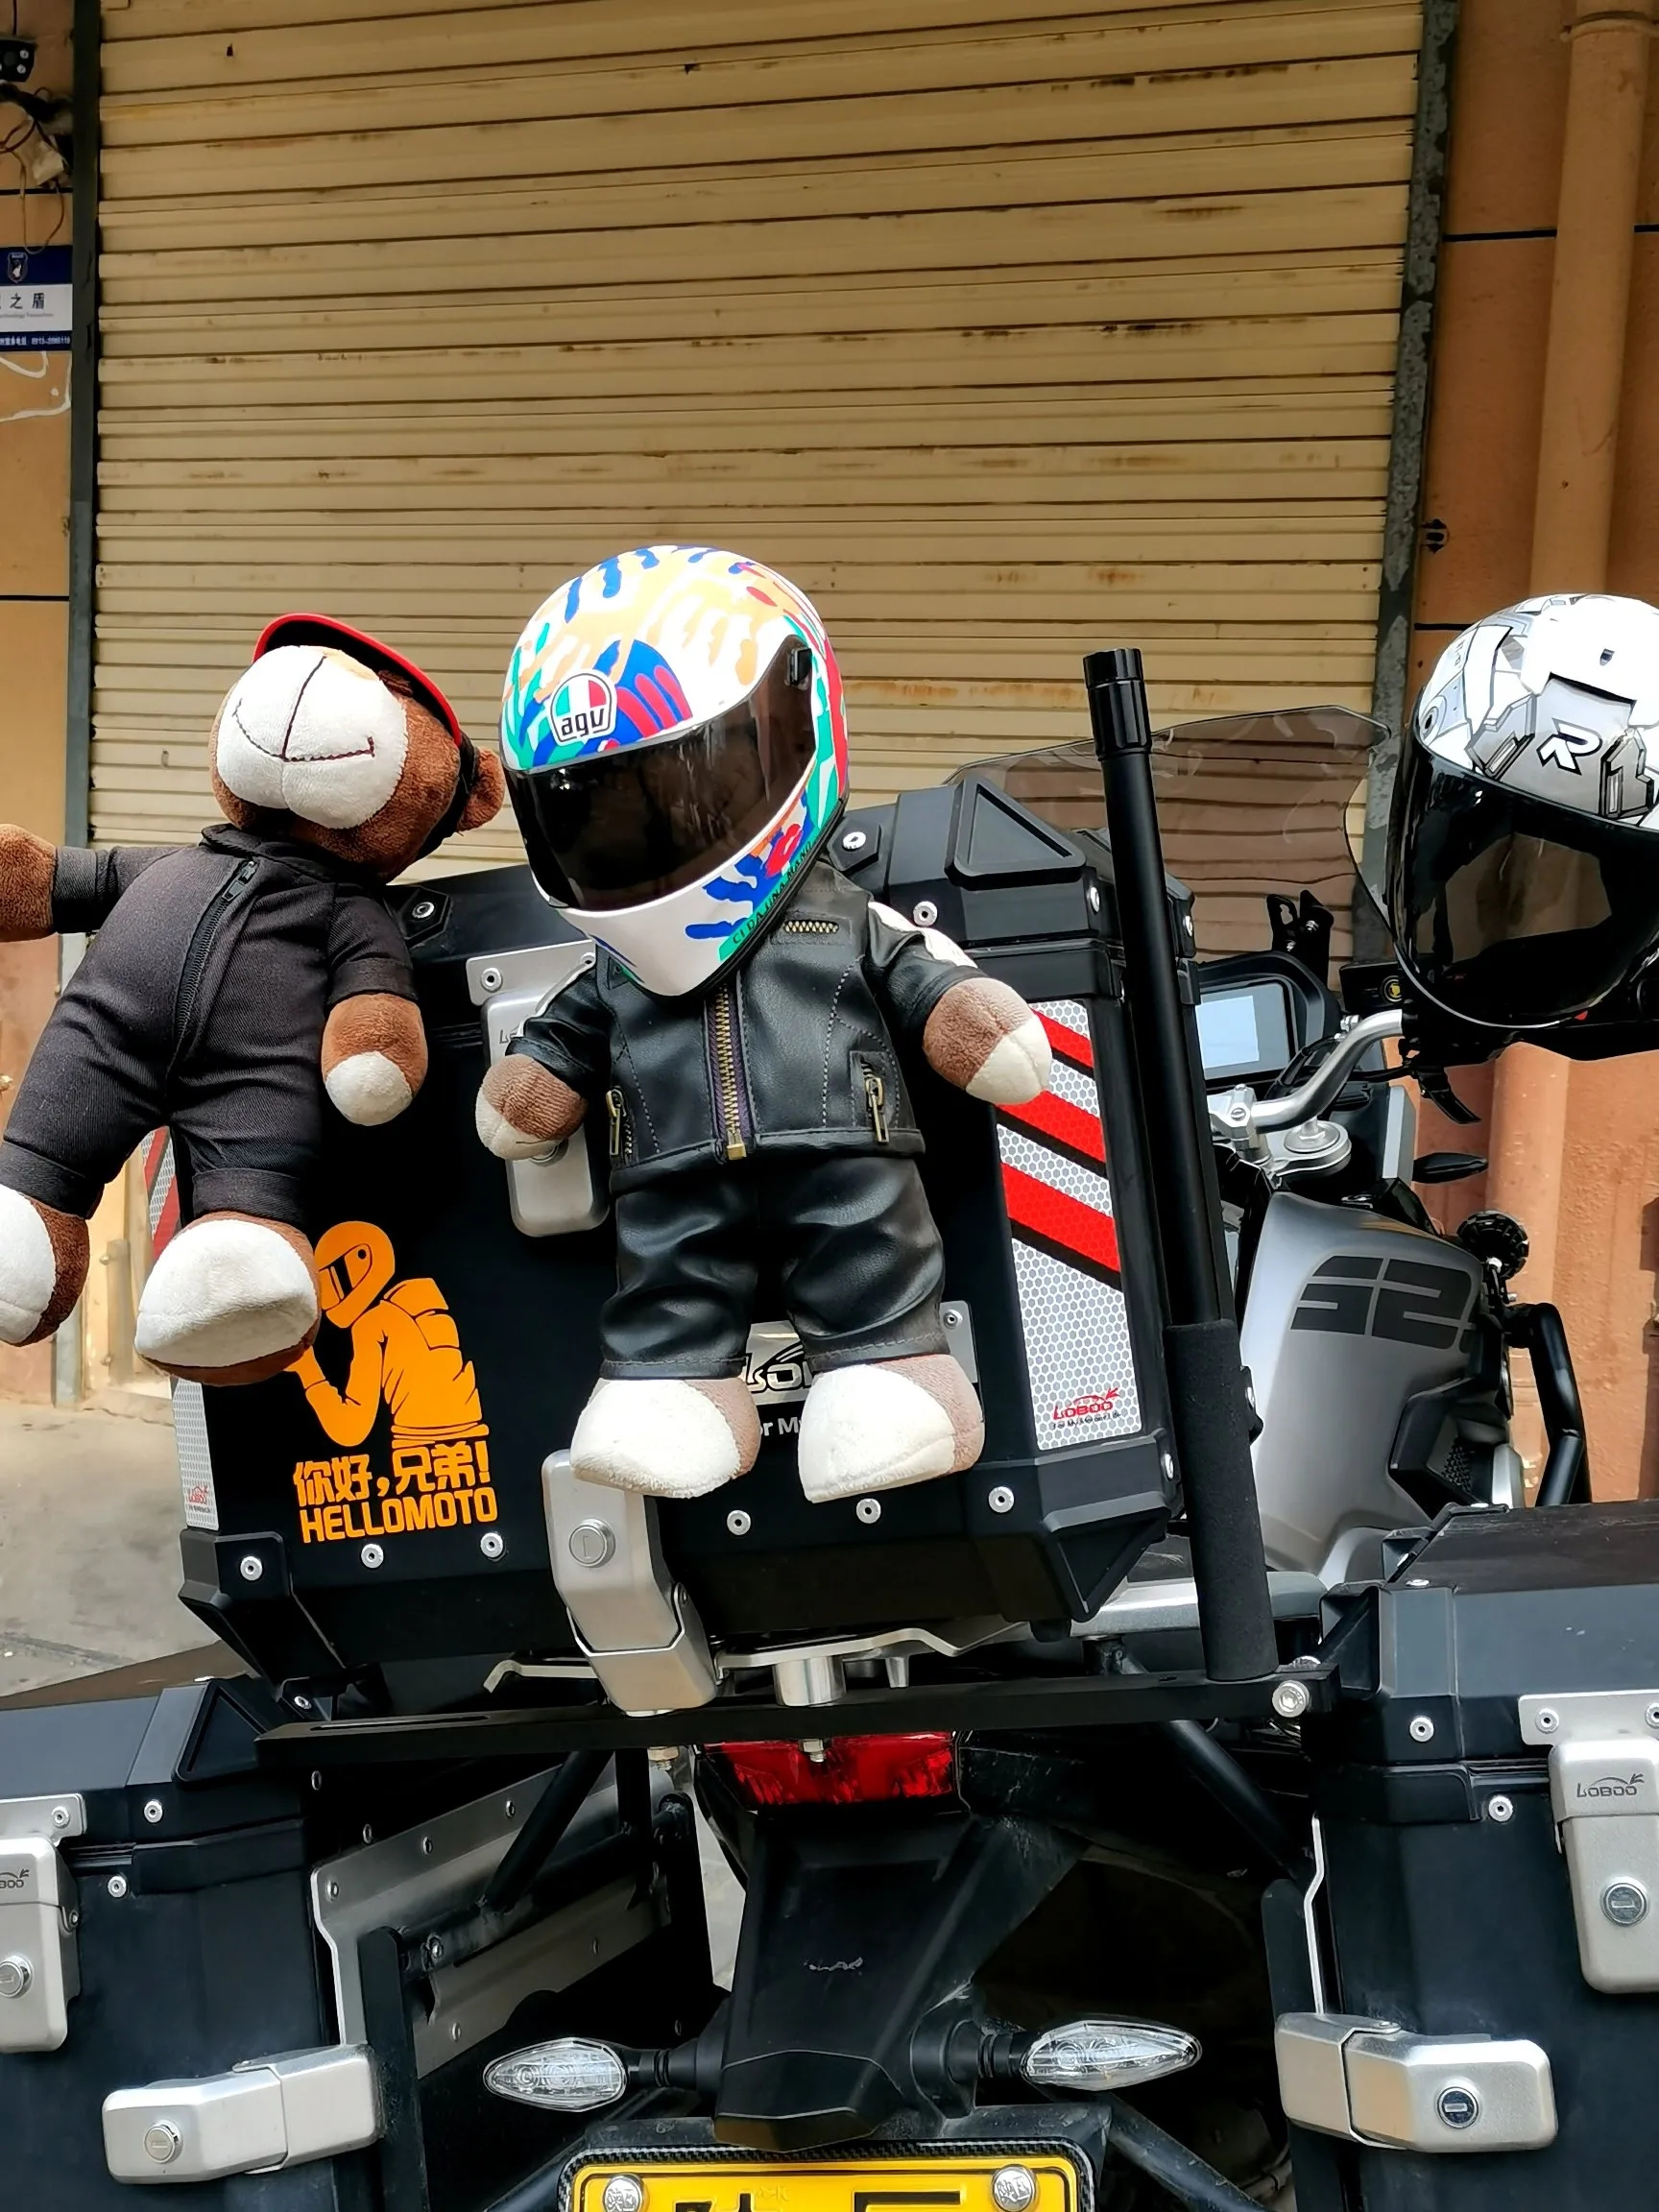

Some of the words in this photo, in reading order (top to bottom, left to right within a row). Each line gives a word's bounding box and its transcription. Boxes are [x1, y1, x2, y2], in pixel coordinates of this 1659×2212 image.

[0, 292, 45, 309] 之盾
[561, 708, 605, 736] agv
[300, 1487, 498, 1543] HELLOMOTO
[1576, 1782, 1638, 1798] LOBOO
